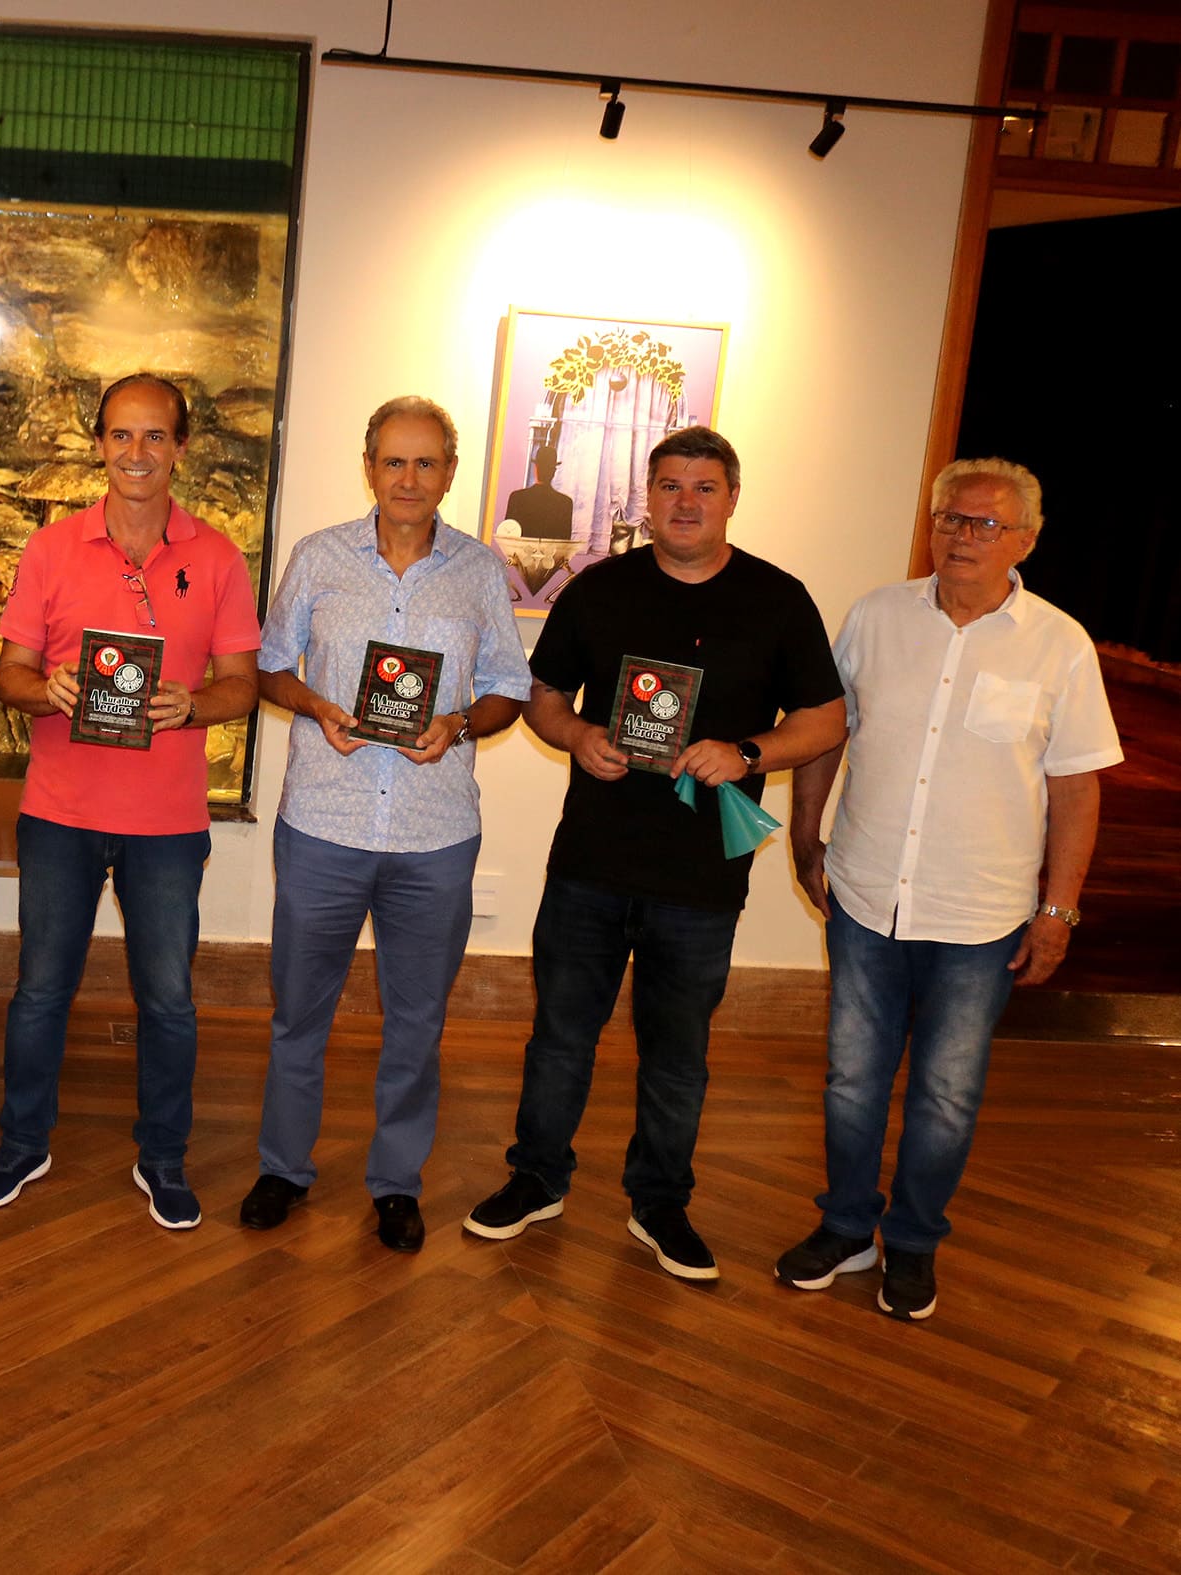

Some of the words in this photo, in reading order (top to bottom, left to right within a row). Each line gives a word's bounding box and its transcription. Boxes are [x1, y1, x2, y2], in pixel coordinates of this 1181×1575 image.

[89, 689, 140, 707] Muralhas
[370, 693, 419, 712] Muralhas
[93, 700, 132, 715] Verdes
[373, 704, 411, 719] Verdes
[624, 713, 675, 734] Muralhas
[627, 726, 666, 741] Verdes
